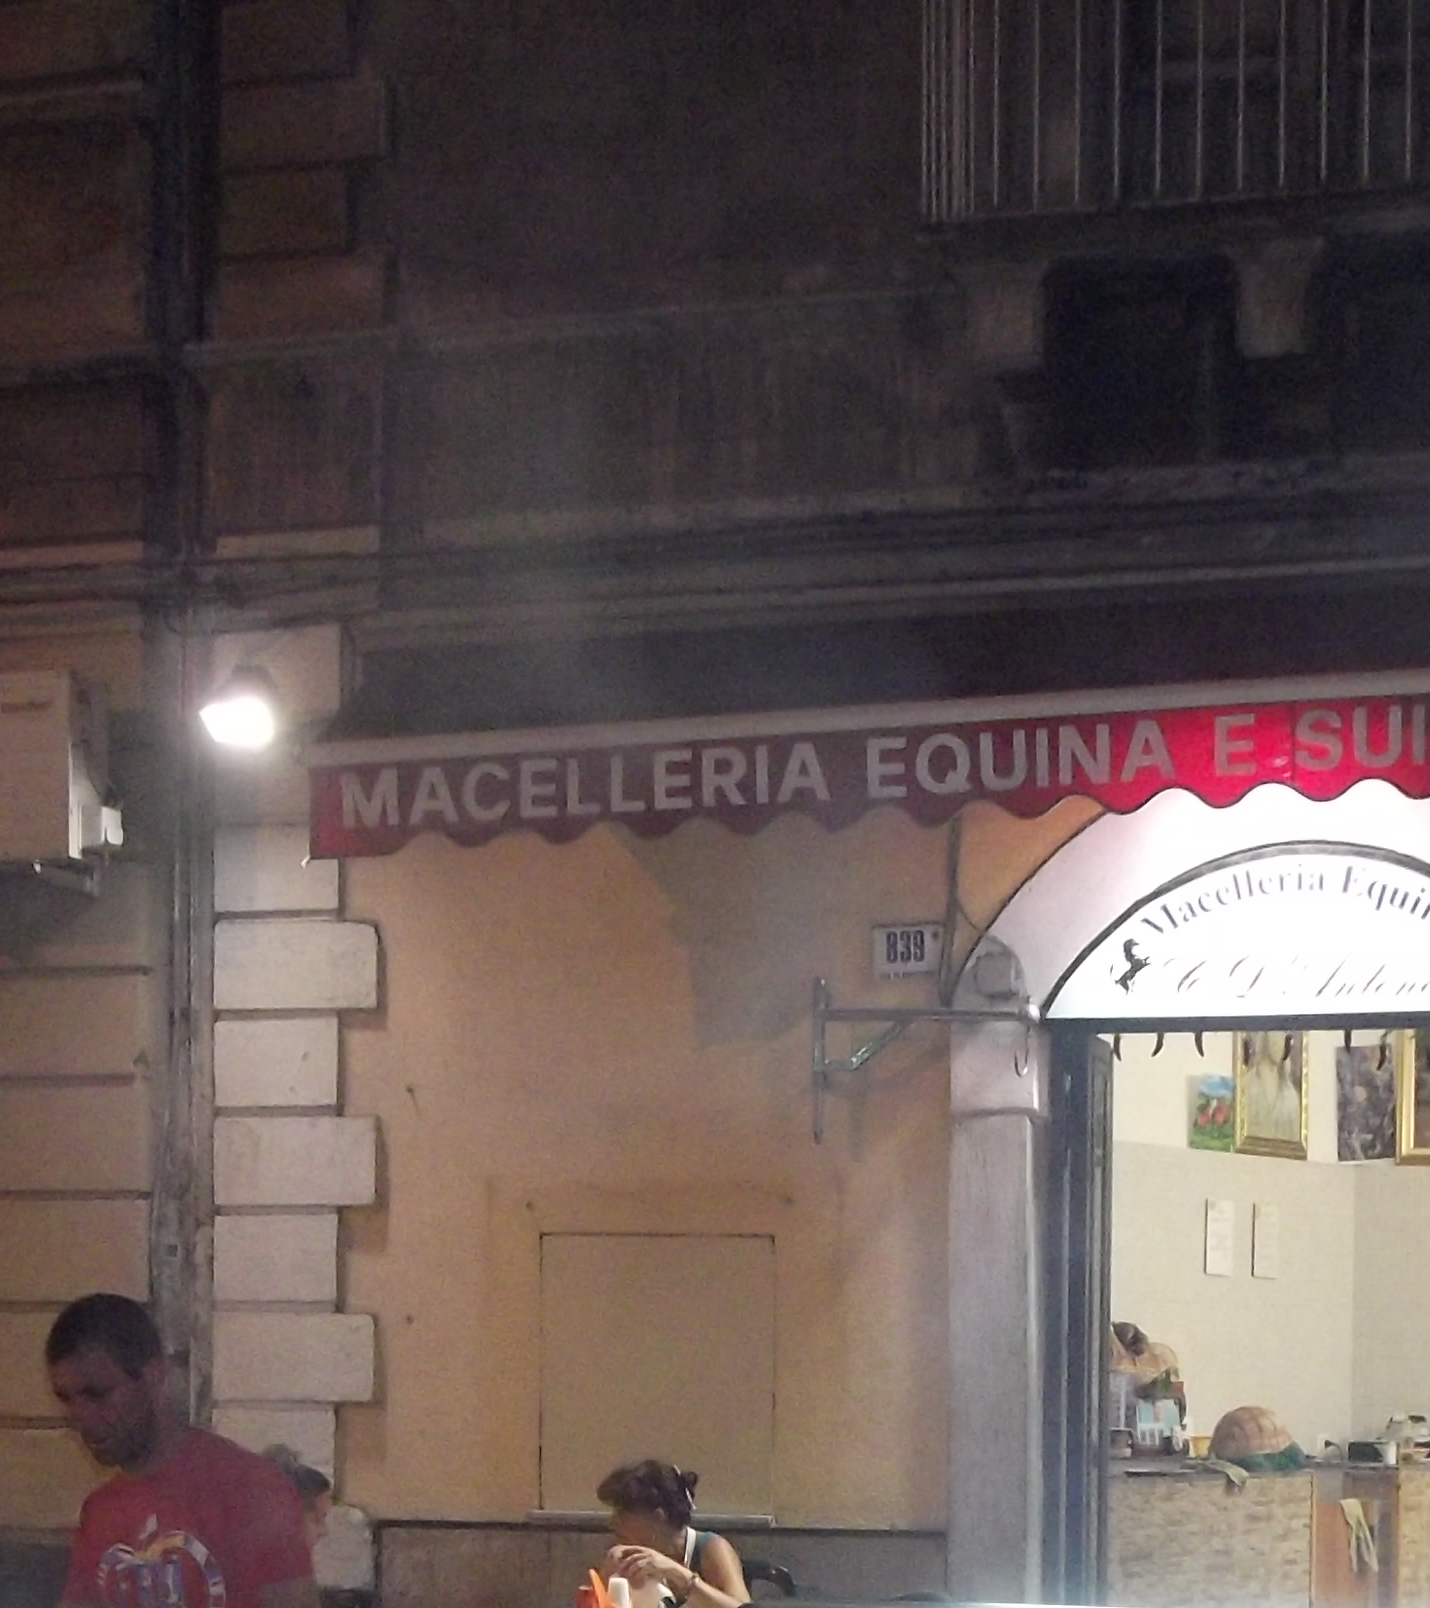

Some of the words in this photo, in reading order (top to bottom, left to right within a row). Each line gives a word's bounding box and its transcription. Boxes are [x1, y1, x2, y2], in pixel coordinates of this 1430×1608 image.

[339, 741, 832, 828] MACELLERIA
[866, 718, 1175, 797] EQUINA
[1213, 712, 1256, 776] E
[1140, 862, 1324, 935] Macelleria
[886, 930, 926, 963] 839
